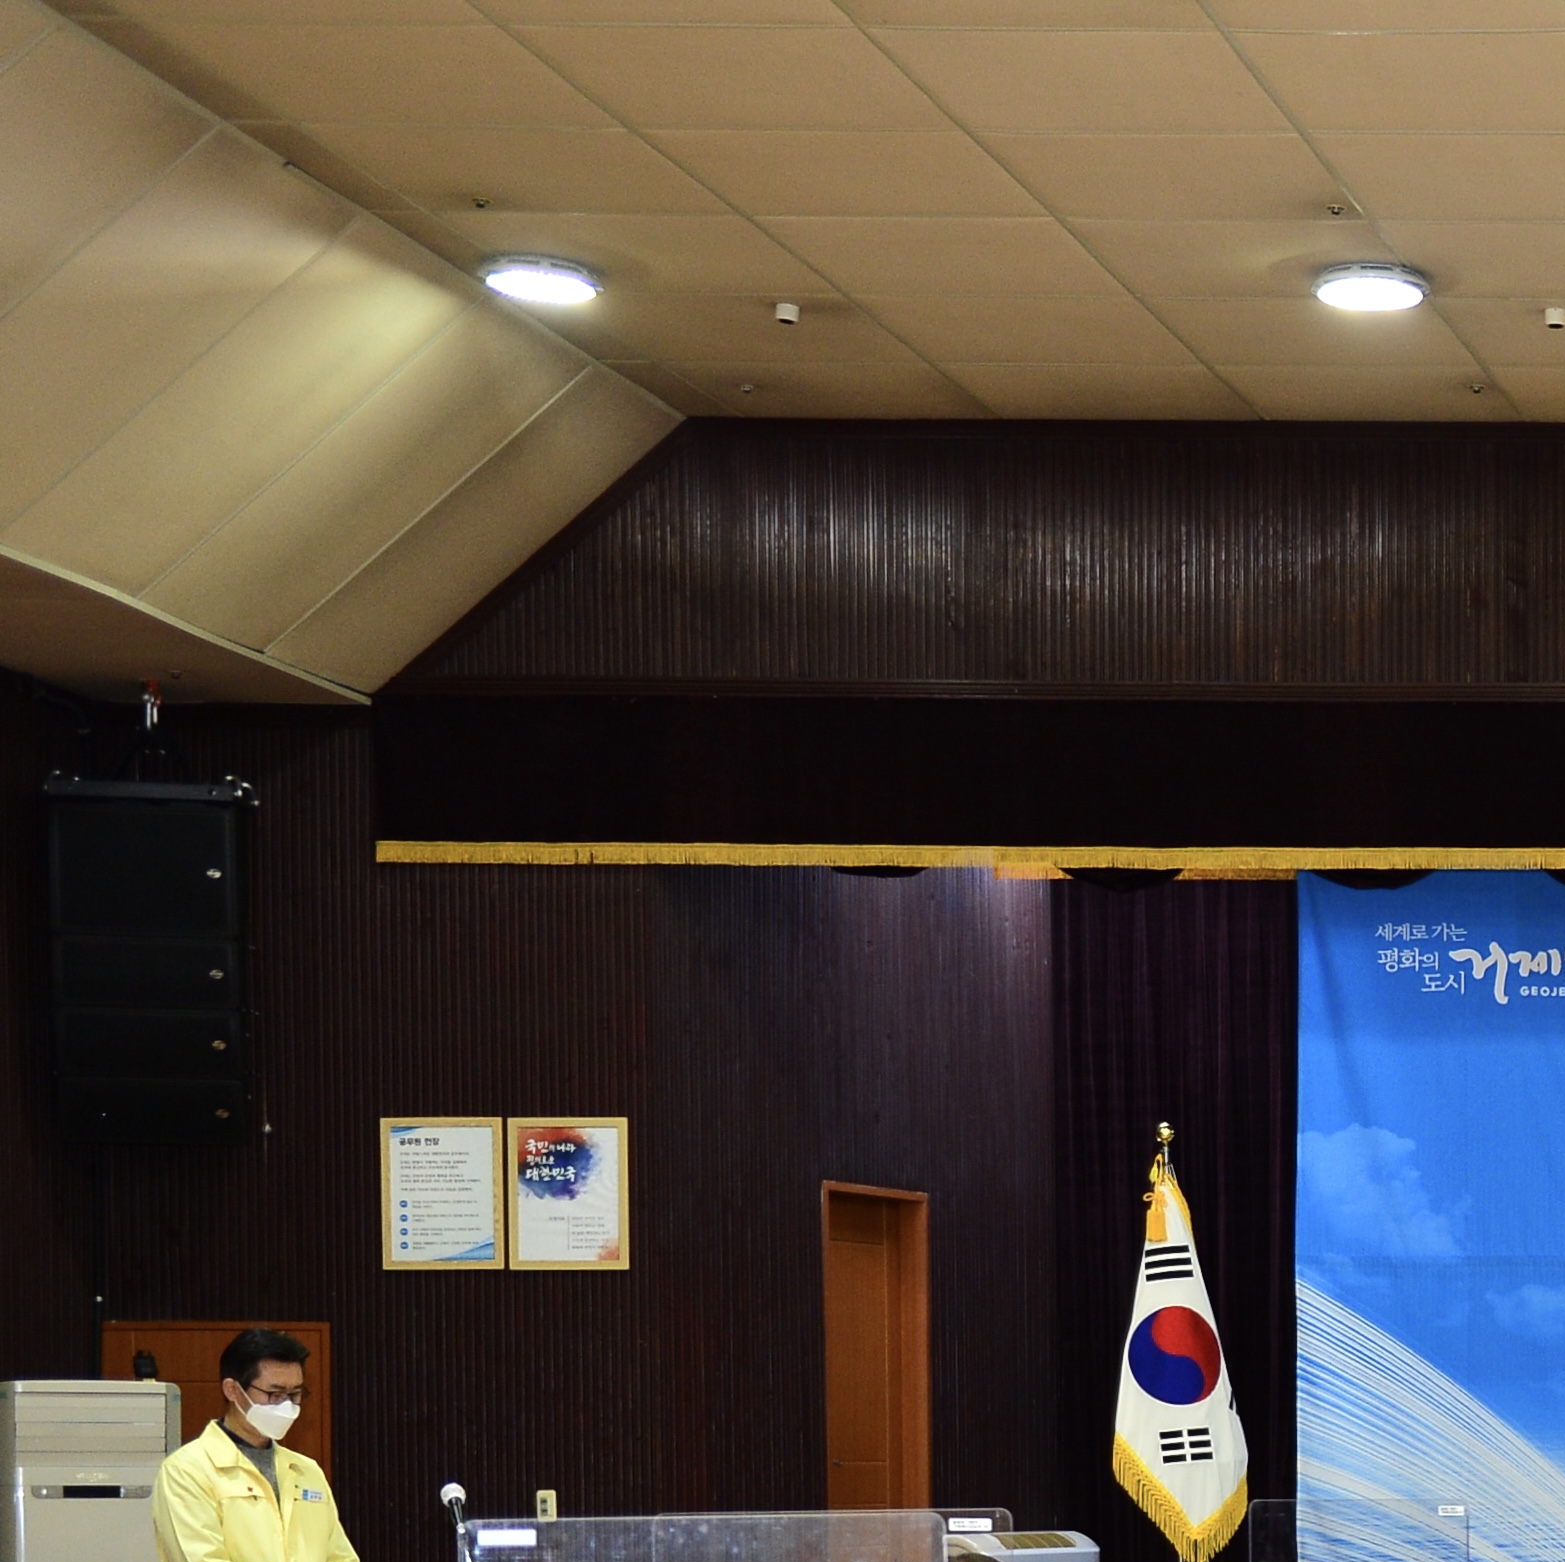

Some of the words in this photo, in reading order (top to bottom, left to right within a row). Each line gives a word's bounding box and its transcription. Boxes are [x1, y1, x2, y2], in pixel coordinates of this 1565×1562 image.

[1375, 923, 1428, 941] 세계로
[1432, 923, 1468, 941] 가는
[1377, 947, 1439, 973] 평화의
[1421, 971, 1465, 994] 도시
[1519, 986, 1565, 997] GEOJE
[525, 1165, 577, 1182] 대한민국
